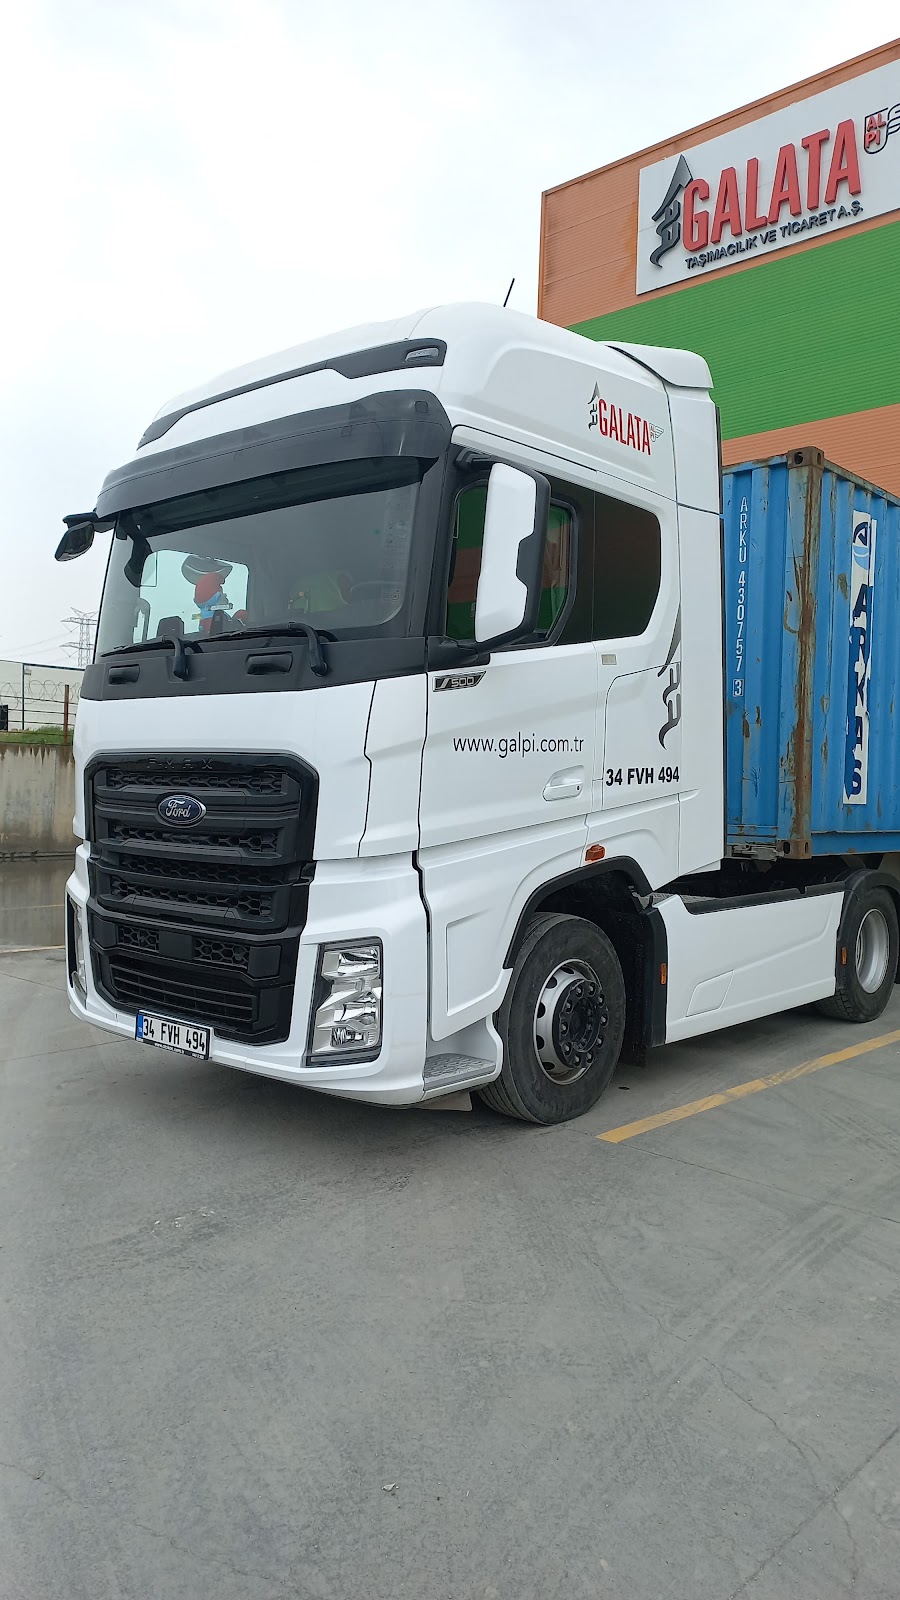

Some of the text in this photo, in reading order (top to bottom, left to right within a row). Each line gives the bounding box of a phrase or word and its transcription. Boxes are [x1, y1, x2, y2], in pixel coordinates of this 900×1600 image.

[867, 113, 886, 132] AL
[865, 130, 881, 148] PI
[683, 118, 862, 252] GALATA
[685, 200, 864, 269] TAŞIMACILIK VE TİCARET A.Ş.
[598, 398, 651, 456] GALATA
[734, 496, 748, 696] ARKU 430757 3
[453, 731, 584, 758] www.galpi.com.tr
[605, 766, 680, 786] 34 FVH 494
[165, 799, 192, 818] Ford
[143, 1018, 155, 1038] 34
[160, 1022, 180, 1046] FVH
[185, 1029, 206, 1052] 494
